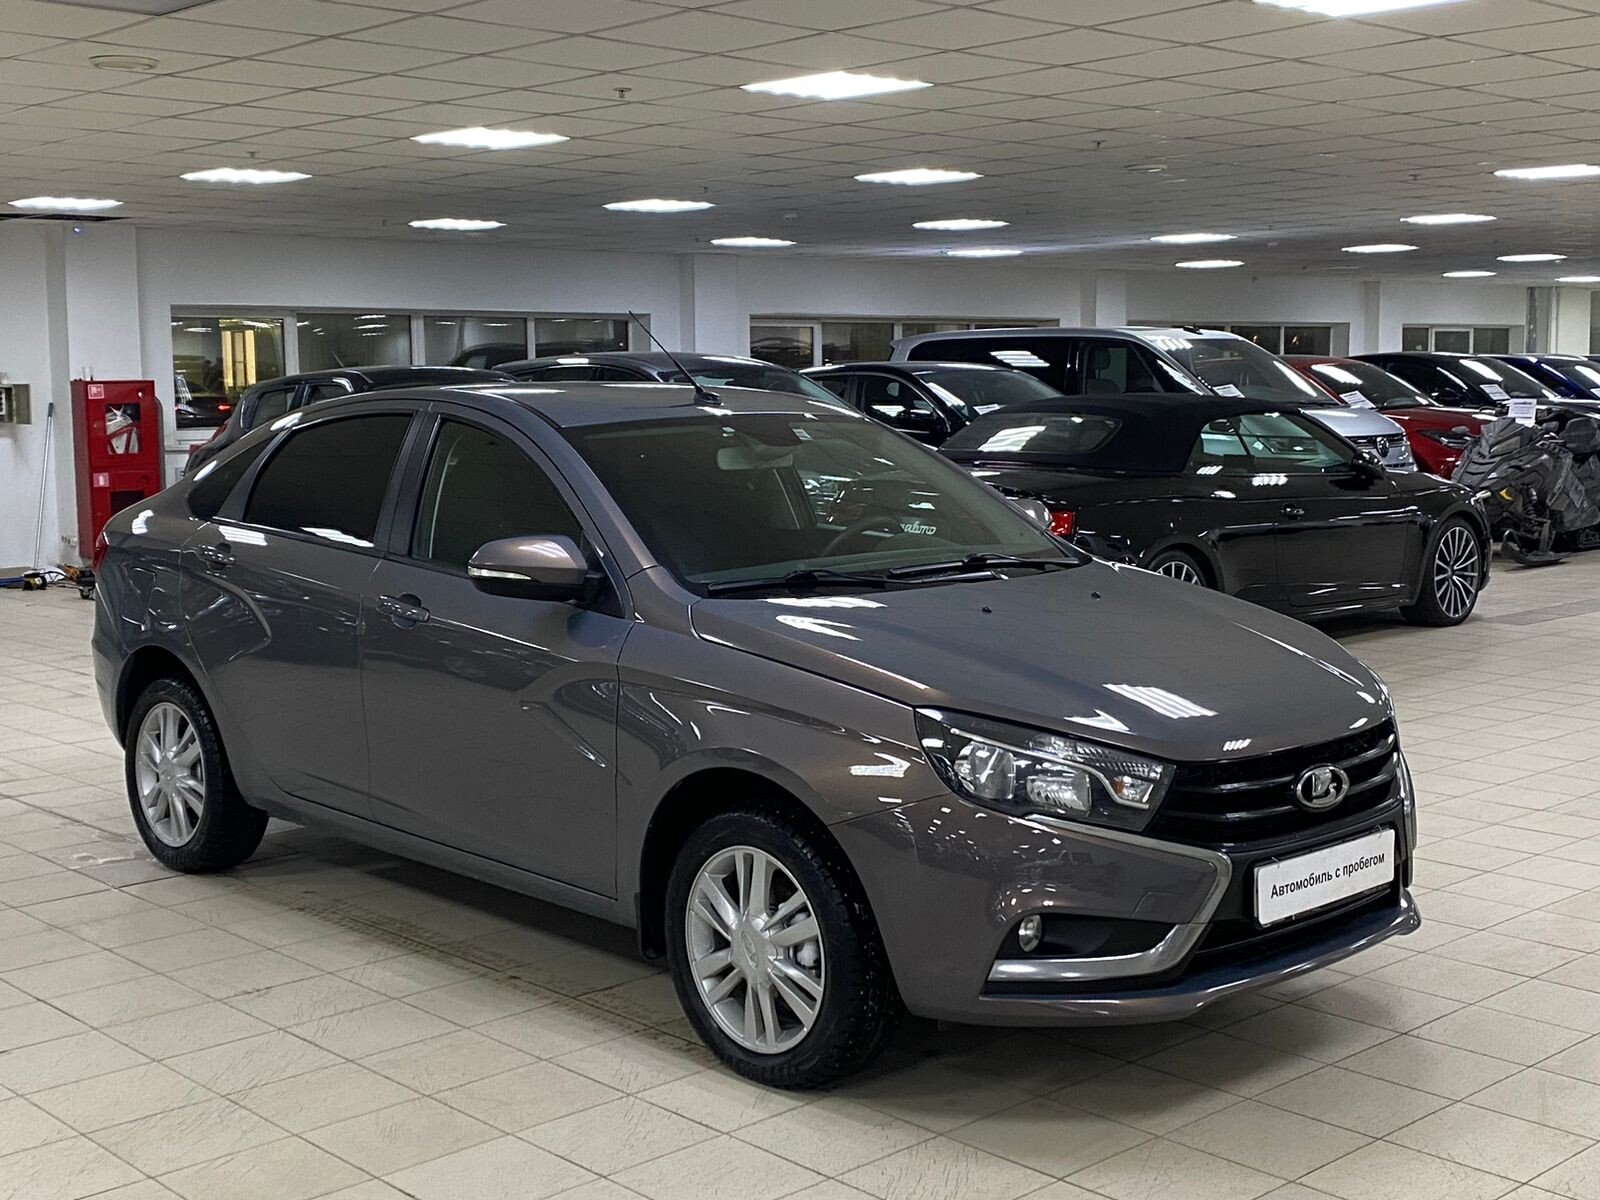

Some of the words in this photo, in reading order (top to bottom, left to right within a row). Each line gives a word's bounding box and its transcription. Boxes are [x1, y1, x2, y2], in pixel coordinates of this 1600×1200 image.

[1271, 871, 1333, 899] Автомобиль
[1335, 868, 1341, 878] с
[1343, 853, 1385, 877] пробегом
